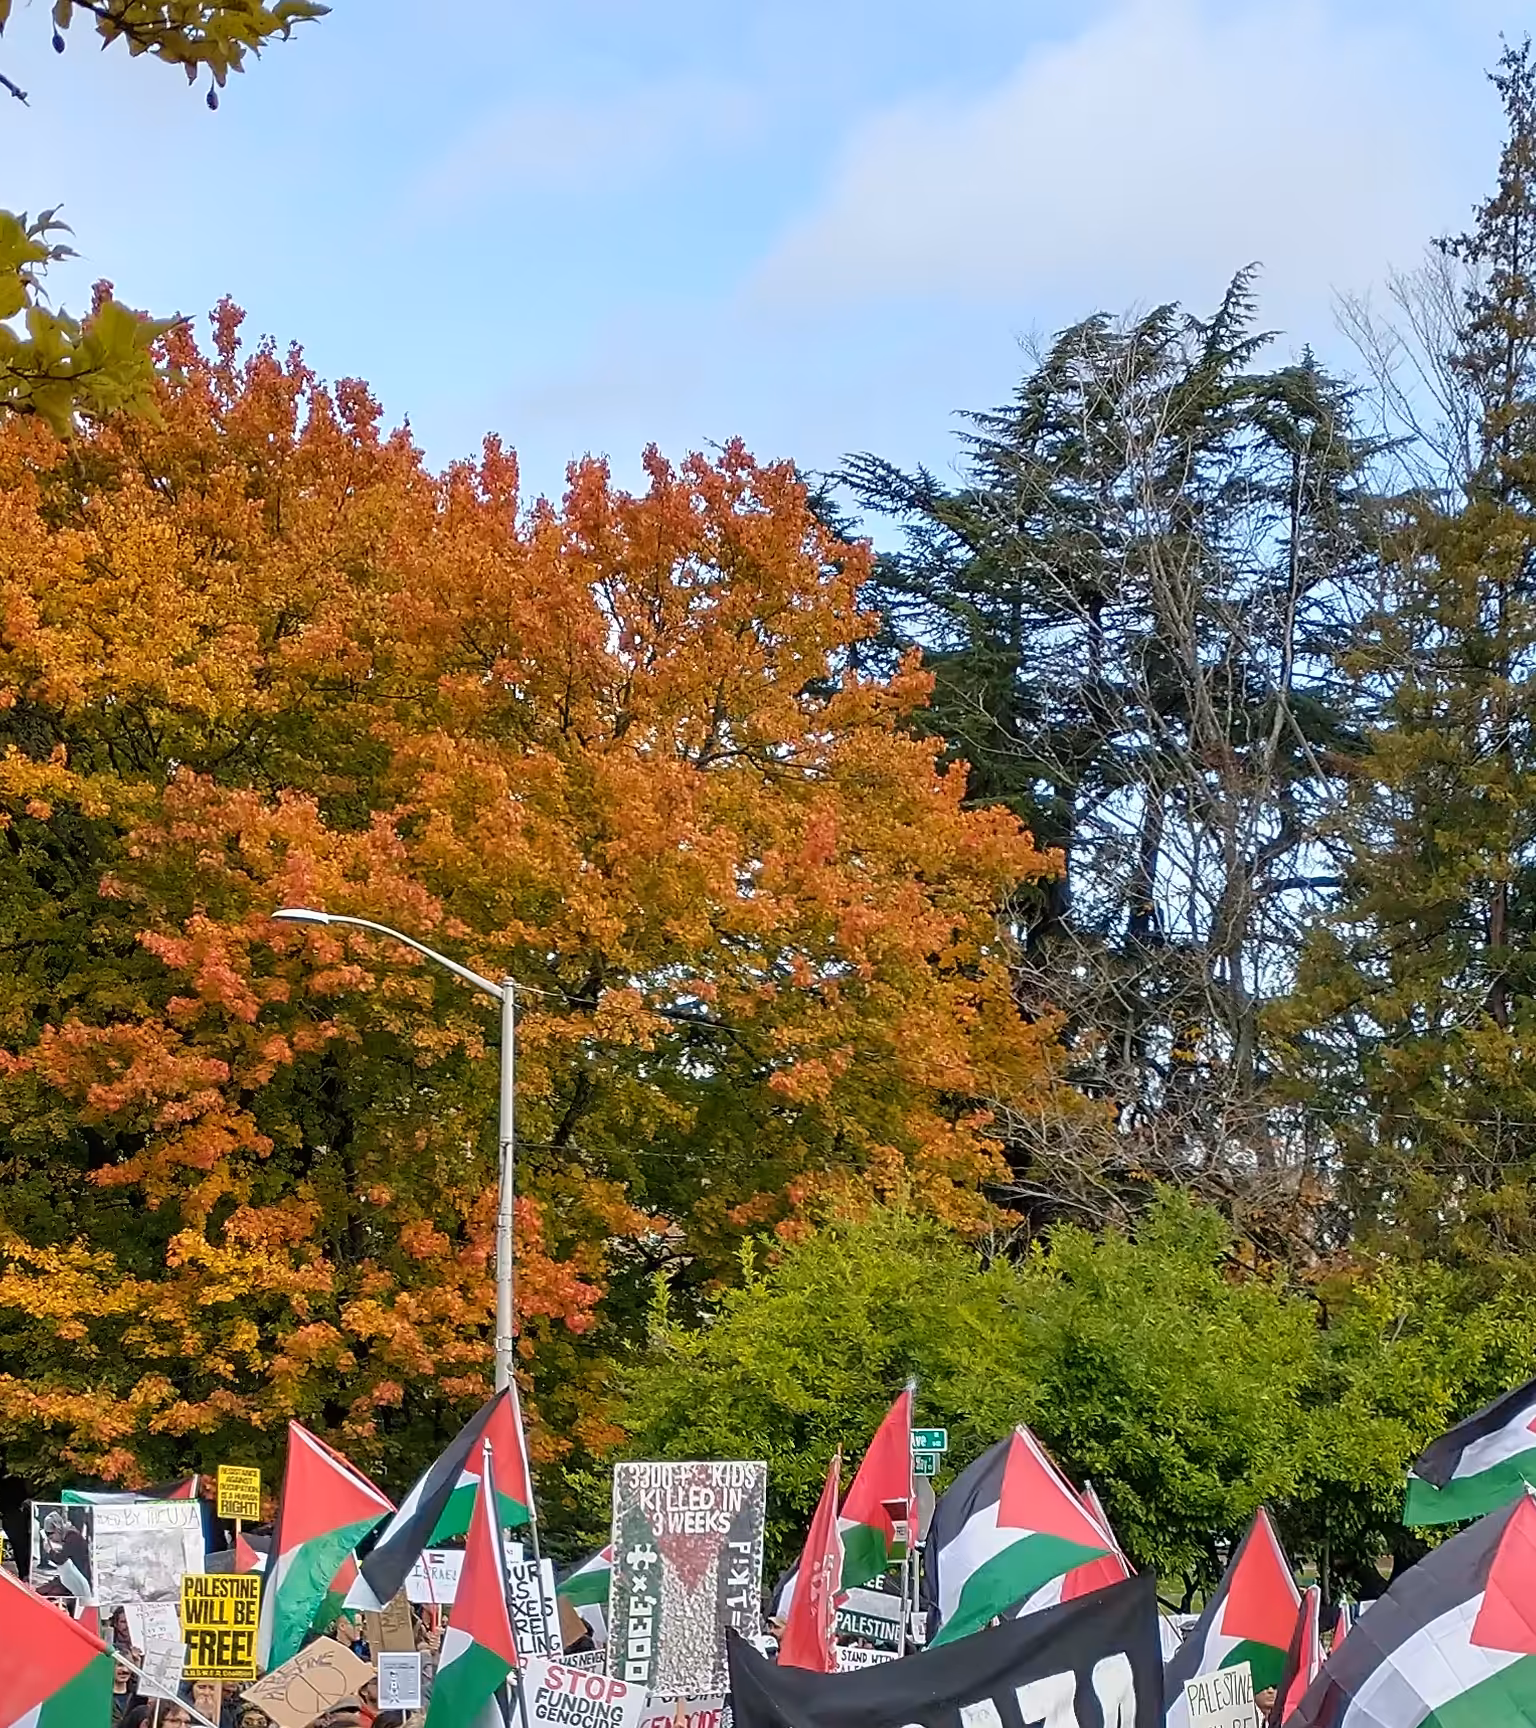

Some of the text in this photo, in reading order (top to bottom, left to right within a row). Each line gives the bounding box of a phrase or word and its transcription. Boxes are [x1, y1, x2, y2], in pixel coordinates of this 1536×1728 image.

[712, 1465, 756, 1488] KIDS
[221, 1500, 258, 1515] RIGHT!
[639, 1488, 742, 1513] KILLED IN
[166, 1507, 201, 1527] USA
[652, 1512, 731, 1536] 3 WEEKS
[411, 1564, 457, 1582] ISRAEL
[184, 1577, 258, 1599] PALESTINE
[184, 1600, 229, 1626] WILL
[233, 1601, 256, 1626] BE
[511, 1597, 554, 1618] XES
[514, 1618, 545, 1635] RE
[835, 1611, 901, 1642] PALESTINE
[184, 1629, 254, 1667] FREE!
[519, 1634, 561, 1654] LING
[841, 1650, 868, 1664] STAND
[544, 1665, 627, 1704] STOP
[1187, 1671, 1253, 1716] PALESTINE
[535, 1687, 624, 1723] FUNDING
